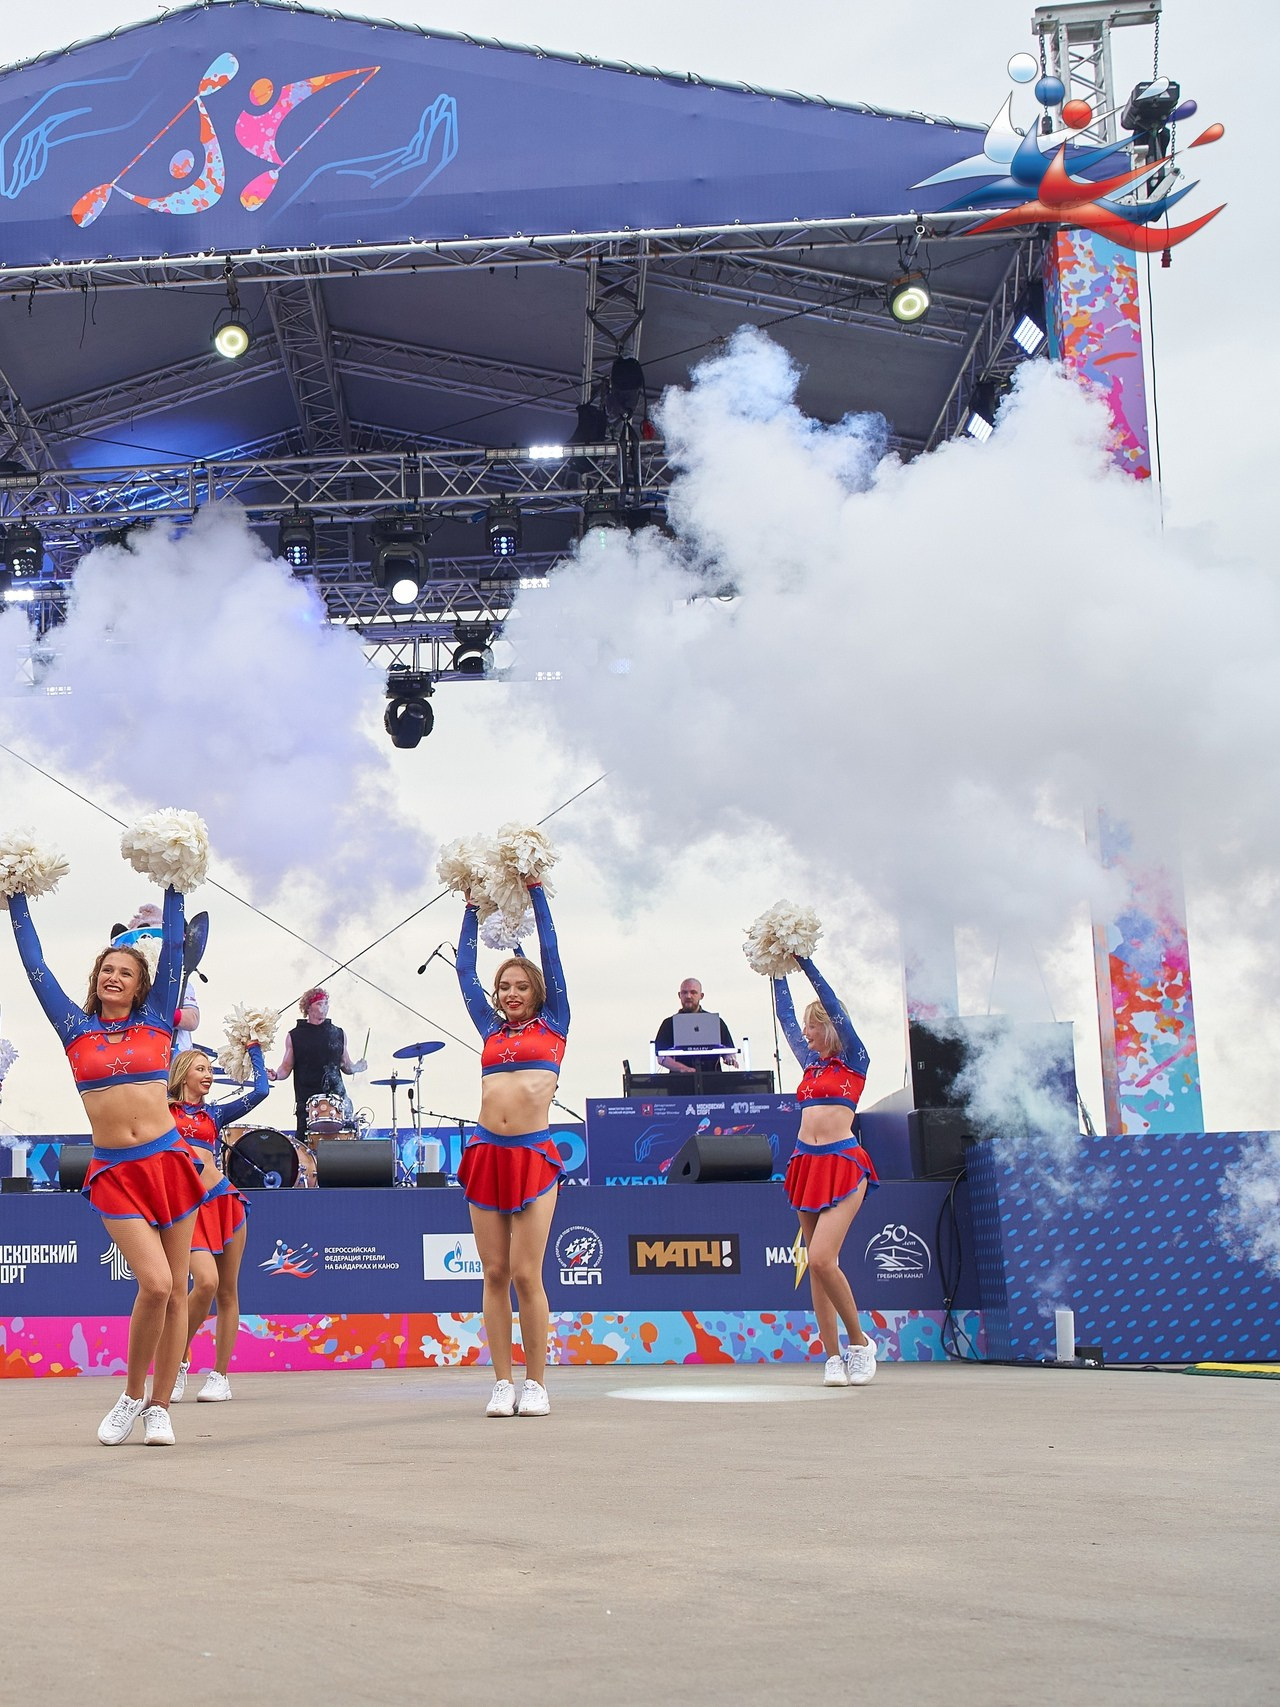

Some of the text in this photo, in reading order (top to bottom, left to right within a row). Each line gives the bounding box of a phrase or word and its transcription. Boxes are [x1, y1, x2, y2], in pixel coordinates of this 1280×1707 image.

[880, 1224, 908, 1244] 50
[636, 1240, 732, 1268] МАТЧ!
[560, 1268, 602, 1284] ЦСП
